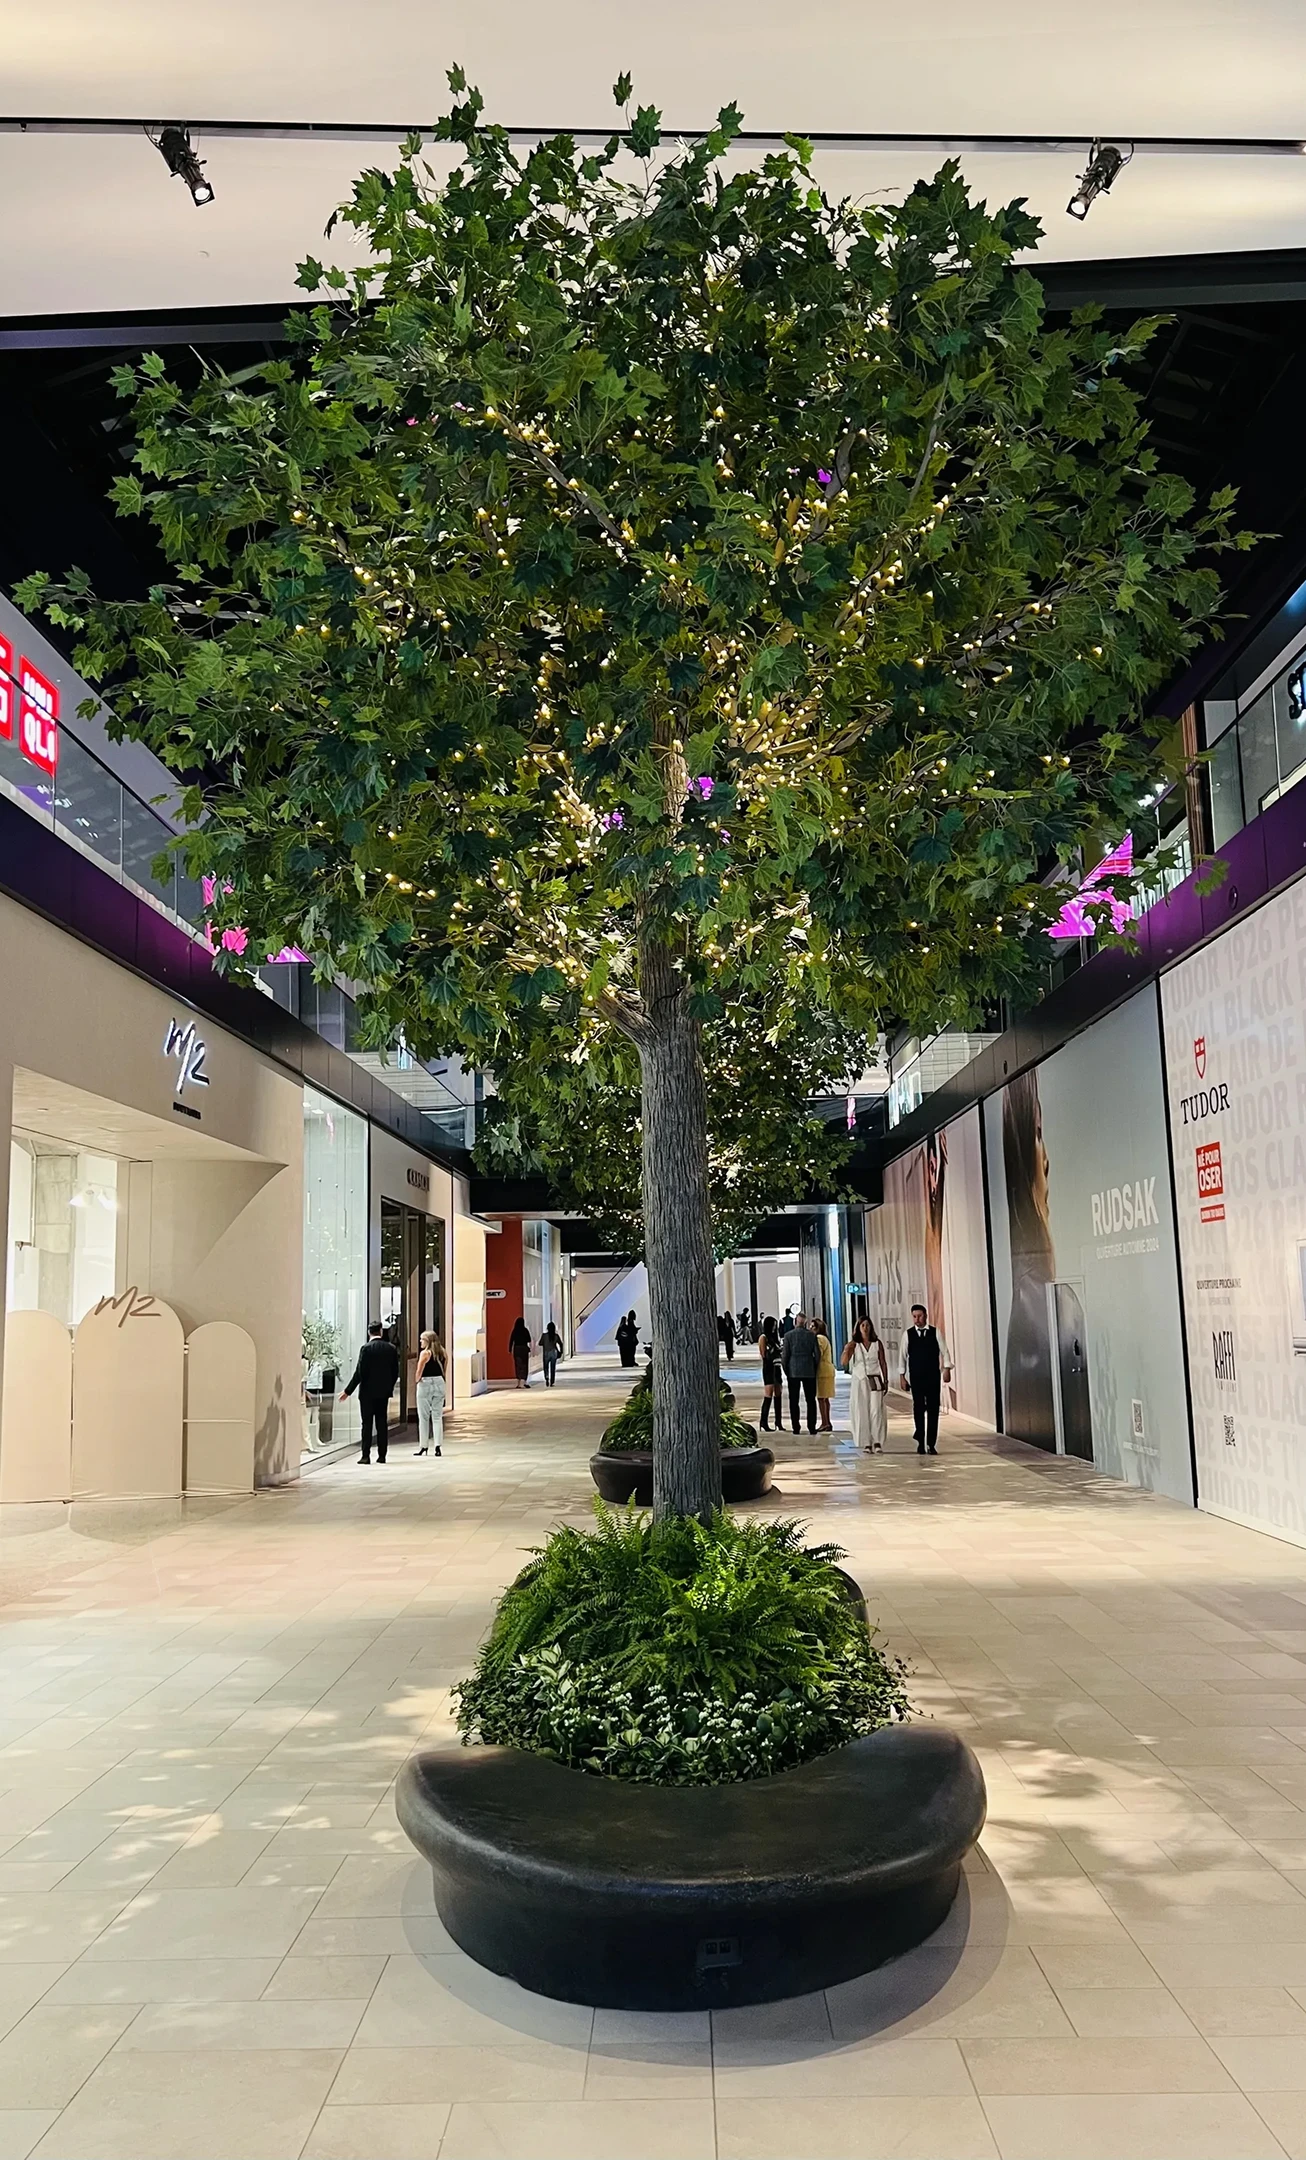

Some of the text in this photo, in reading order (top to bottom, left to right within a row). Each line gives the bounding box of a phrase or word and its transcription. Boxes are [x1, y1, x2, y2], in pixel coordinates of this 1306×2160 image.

[1161, 945, 1222, 1018] TUDOR
[1180, 1083, 1231, 1126] TUDOR
[1199, 1166, 1222, 1191] OSER
[1205, 1149, 1220, 1166] POUR
[1091, 1175, 1160, 1237] RUDSAK
[1096, 1243, 1123, 1260] OUVERTURE
[1145, 1237, 1160, 1252] 2024
[1211, 1331, 1237, 1381] RAFFI
